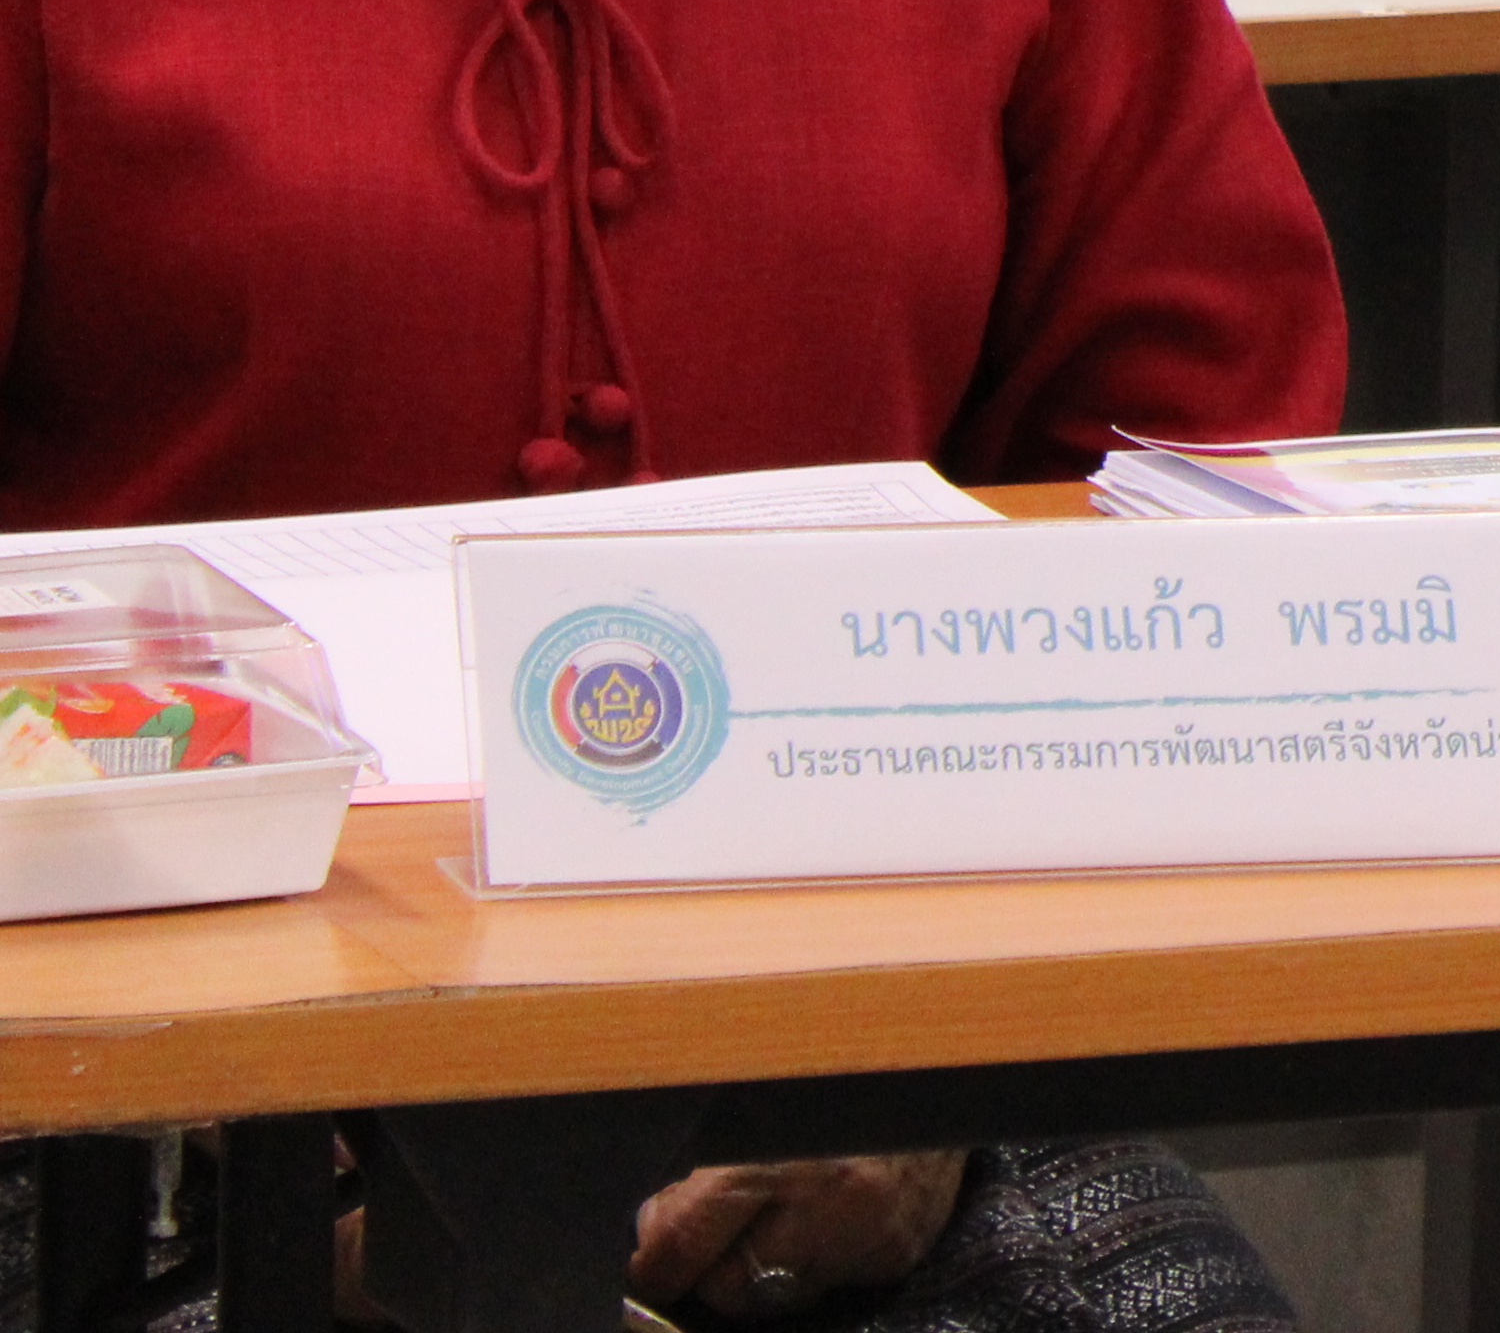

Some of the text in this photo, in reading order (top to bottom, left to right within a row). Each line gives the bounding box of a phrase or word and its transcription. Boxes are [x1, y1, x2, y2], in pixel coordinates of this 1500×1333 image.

[840, 575, 1459, 659] นางพวงแก้ว พรมมิ
